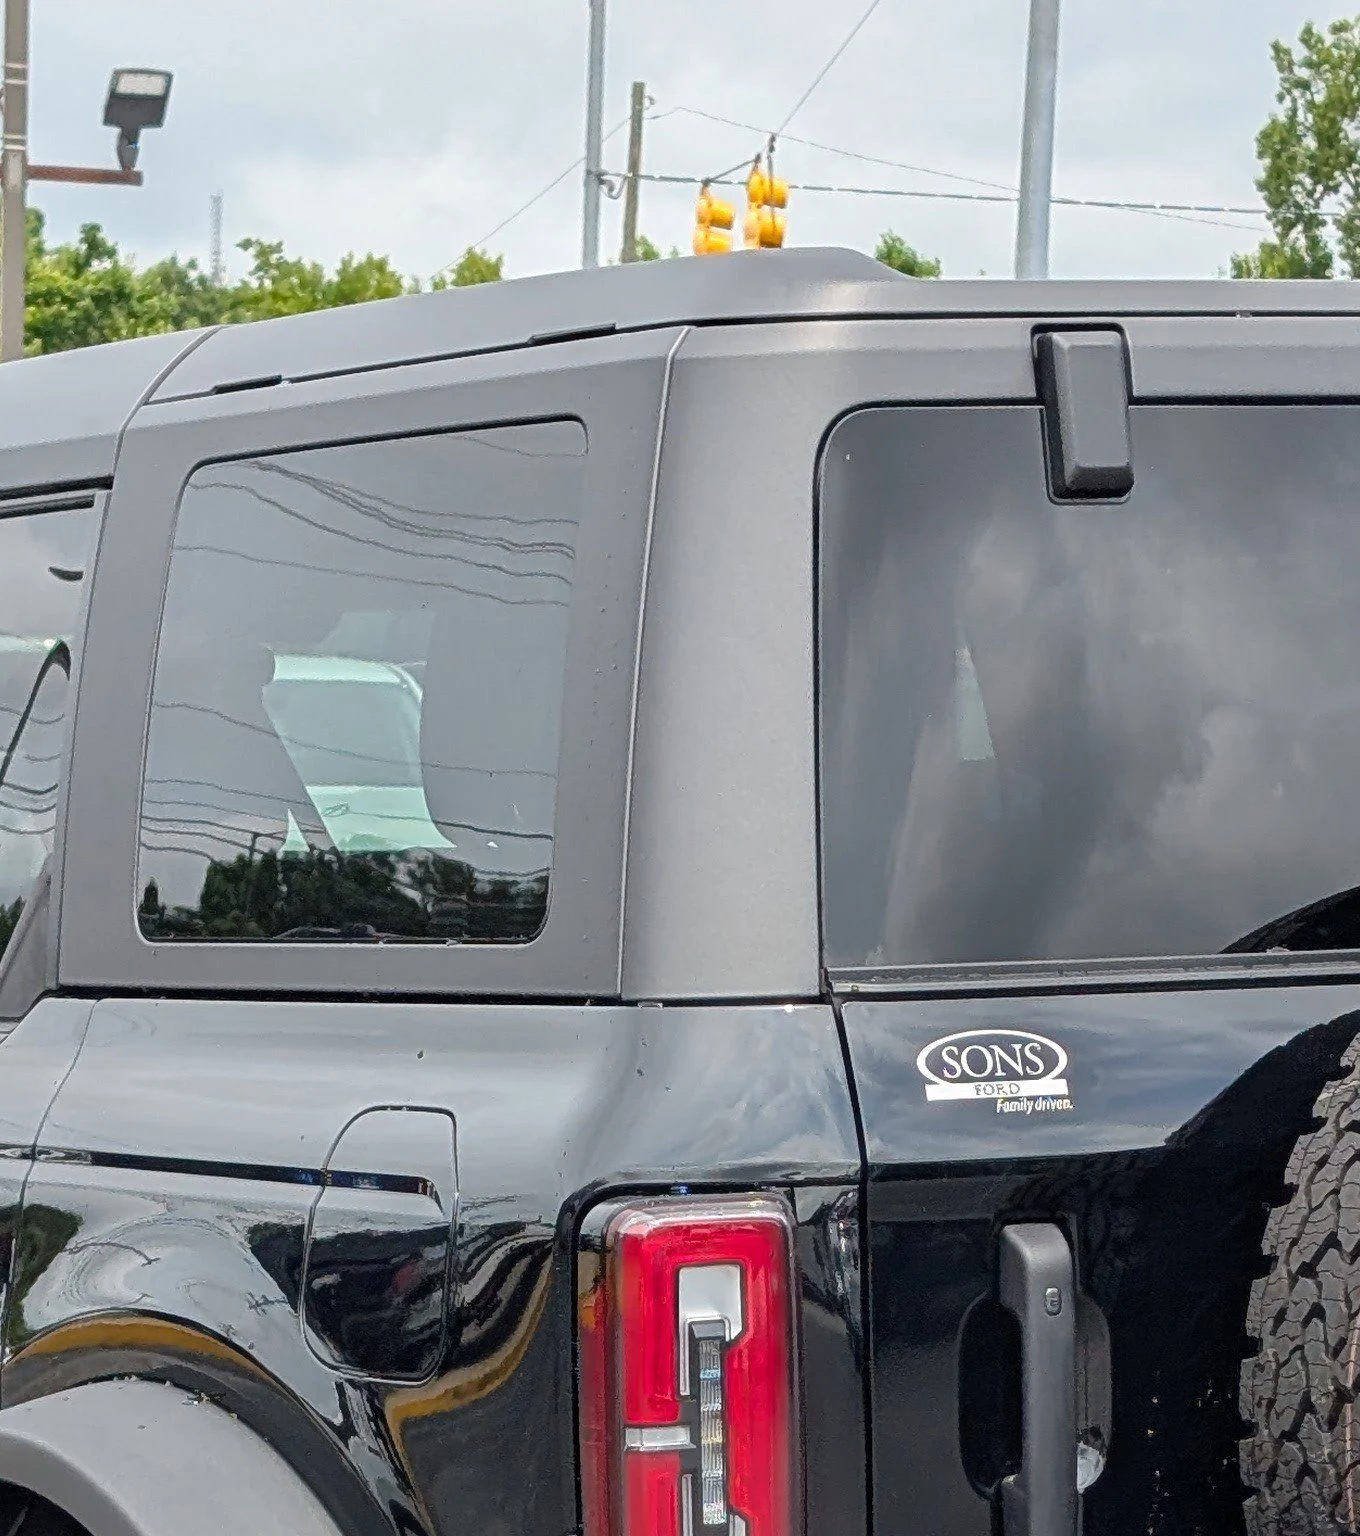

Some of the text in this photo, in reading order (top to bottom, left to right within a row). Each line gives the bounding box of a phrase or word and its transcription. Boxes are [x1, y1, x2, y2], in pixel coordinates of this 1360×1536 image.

[941, 1042, 1045, 1079] SONS
[974, 1082, 1021, 1096] FORD
[996, 1096, 1033, 1115] Family
